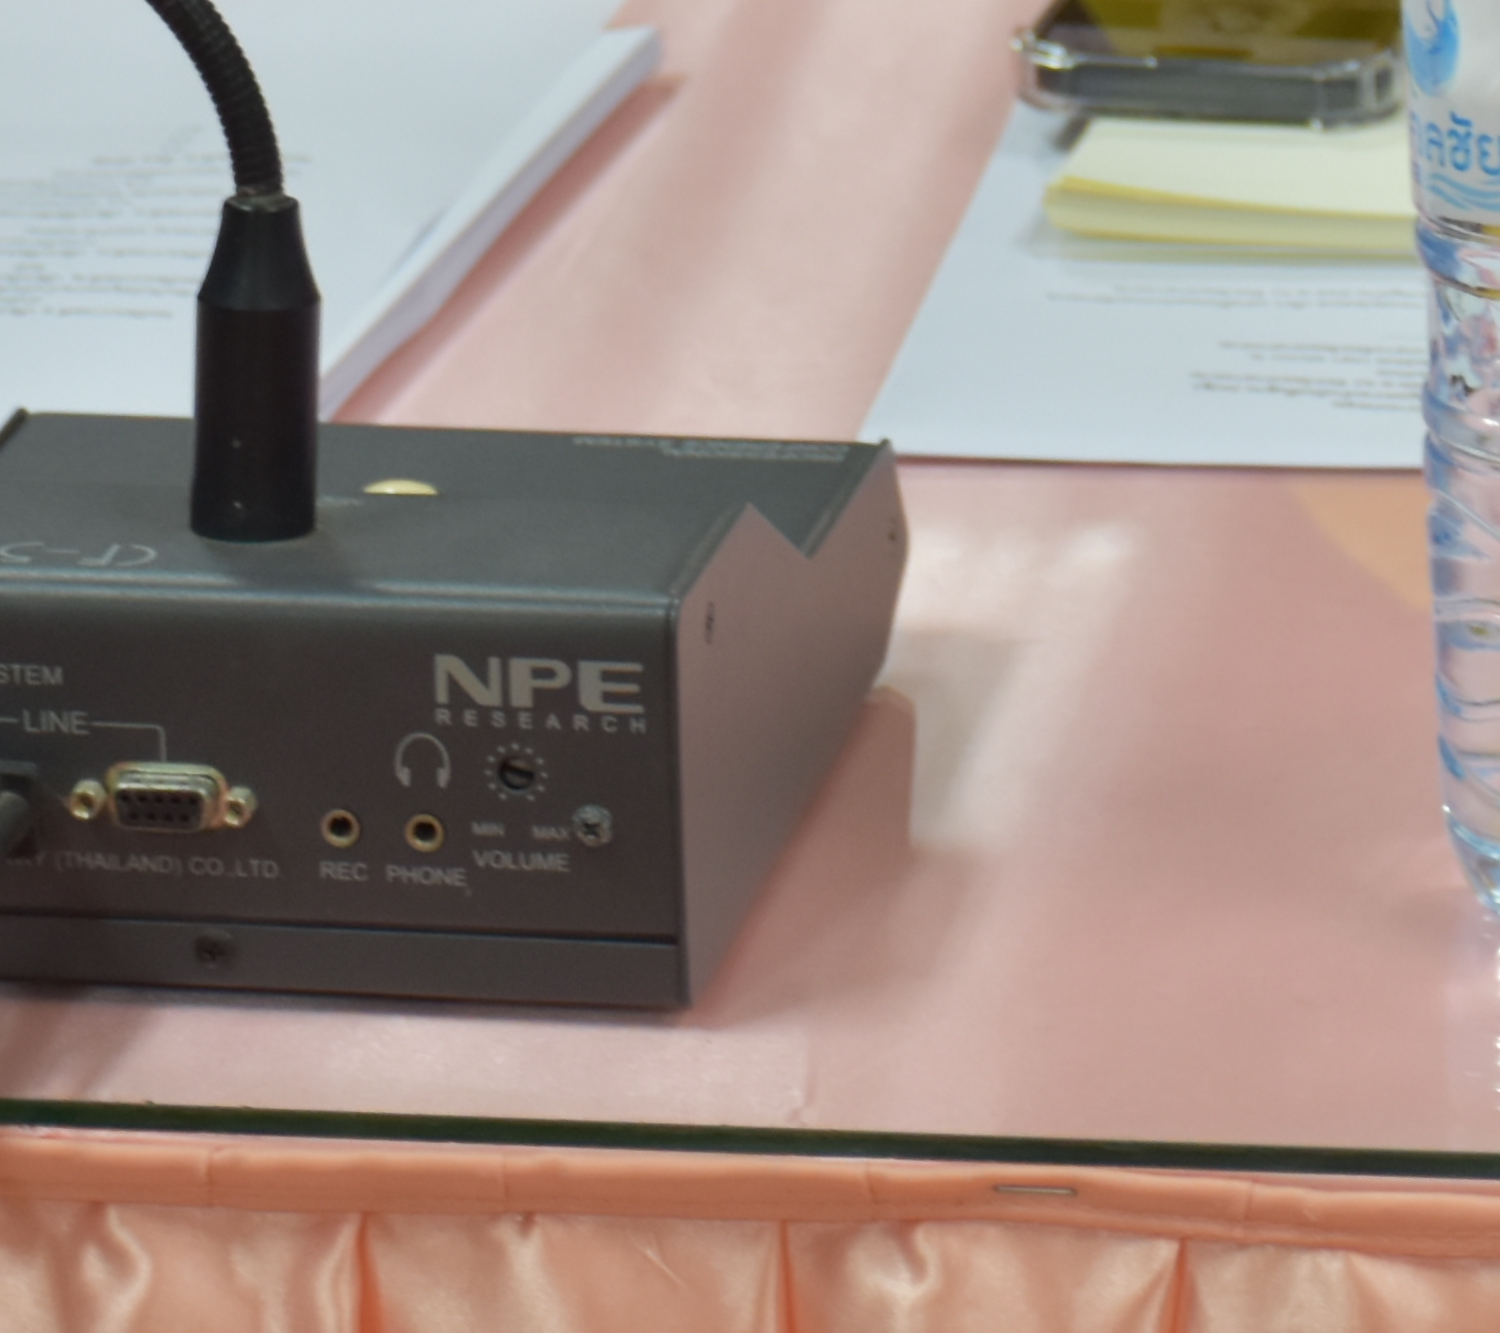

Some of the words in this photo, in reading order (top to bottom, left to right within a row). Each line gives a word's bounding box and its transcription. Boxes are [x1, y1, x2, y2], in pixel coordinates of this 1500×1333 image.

[433, 653, 645, 715] NPE
[22, 708, 90, 735] LINE
[434, 708, 647, 734] RESEARCH
[471, 821, 505, 838] MIN
[318, 860, 369, 883] REC
[385, 864, 469, 887] PHONE
[471, 849, 572, 873] VOLUME
